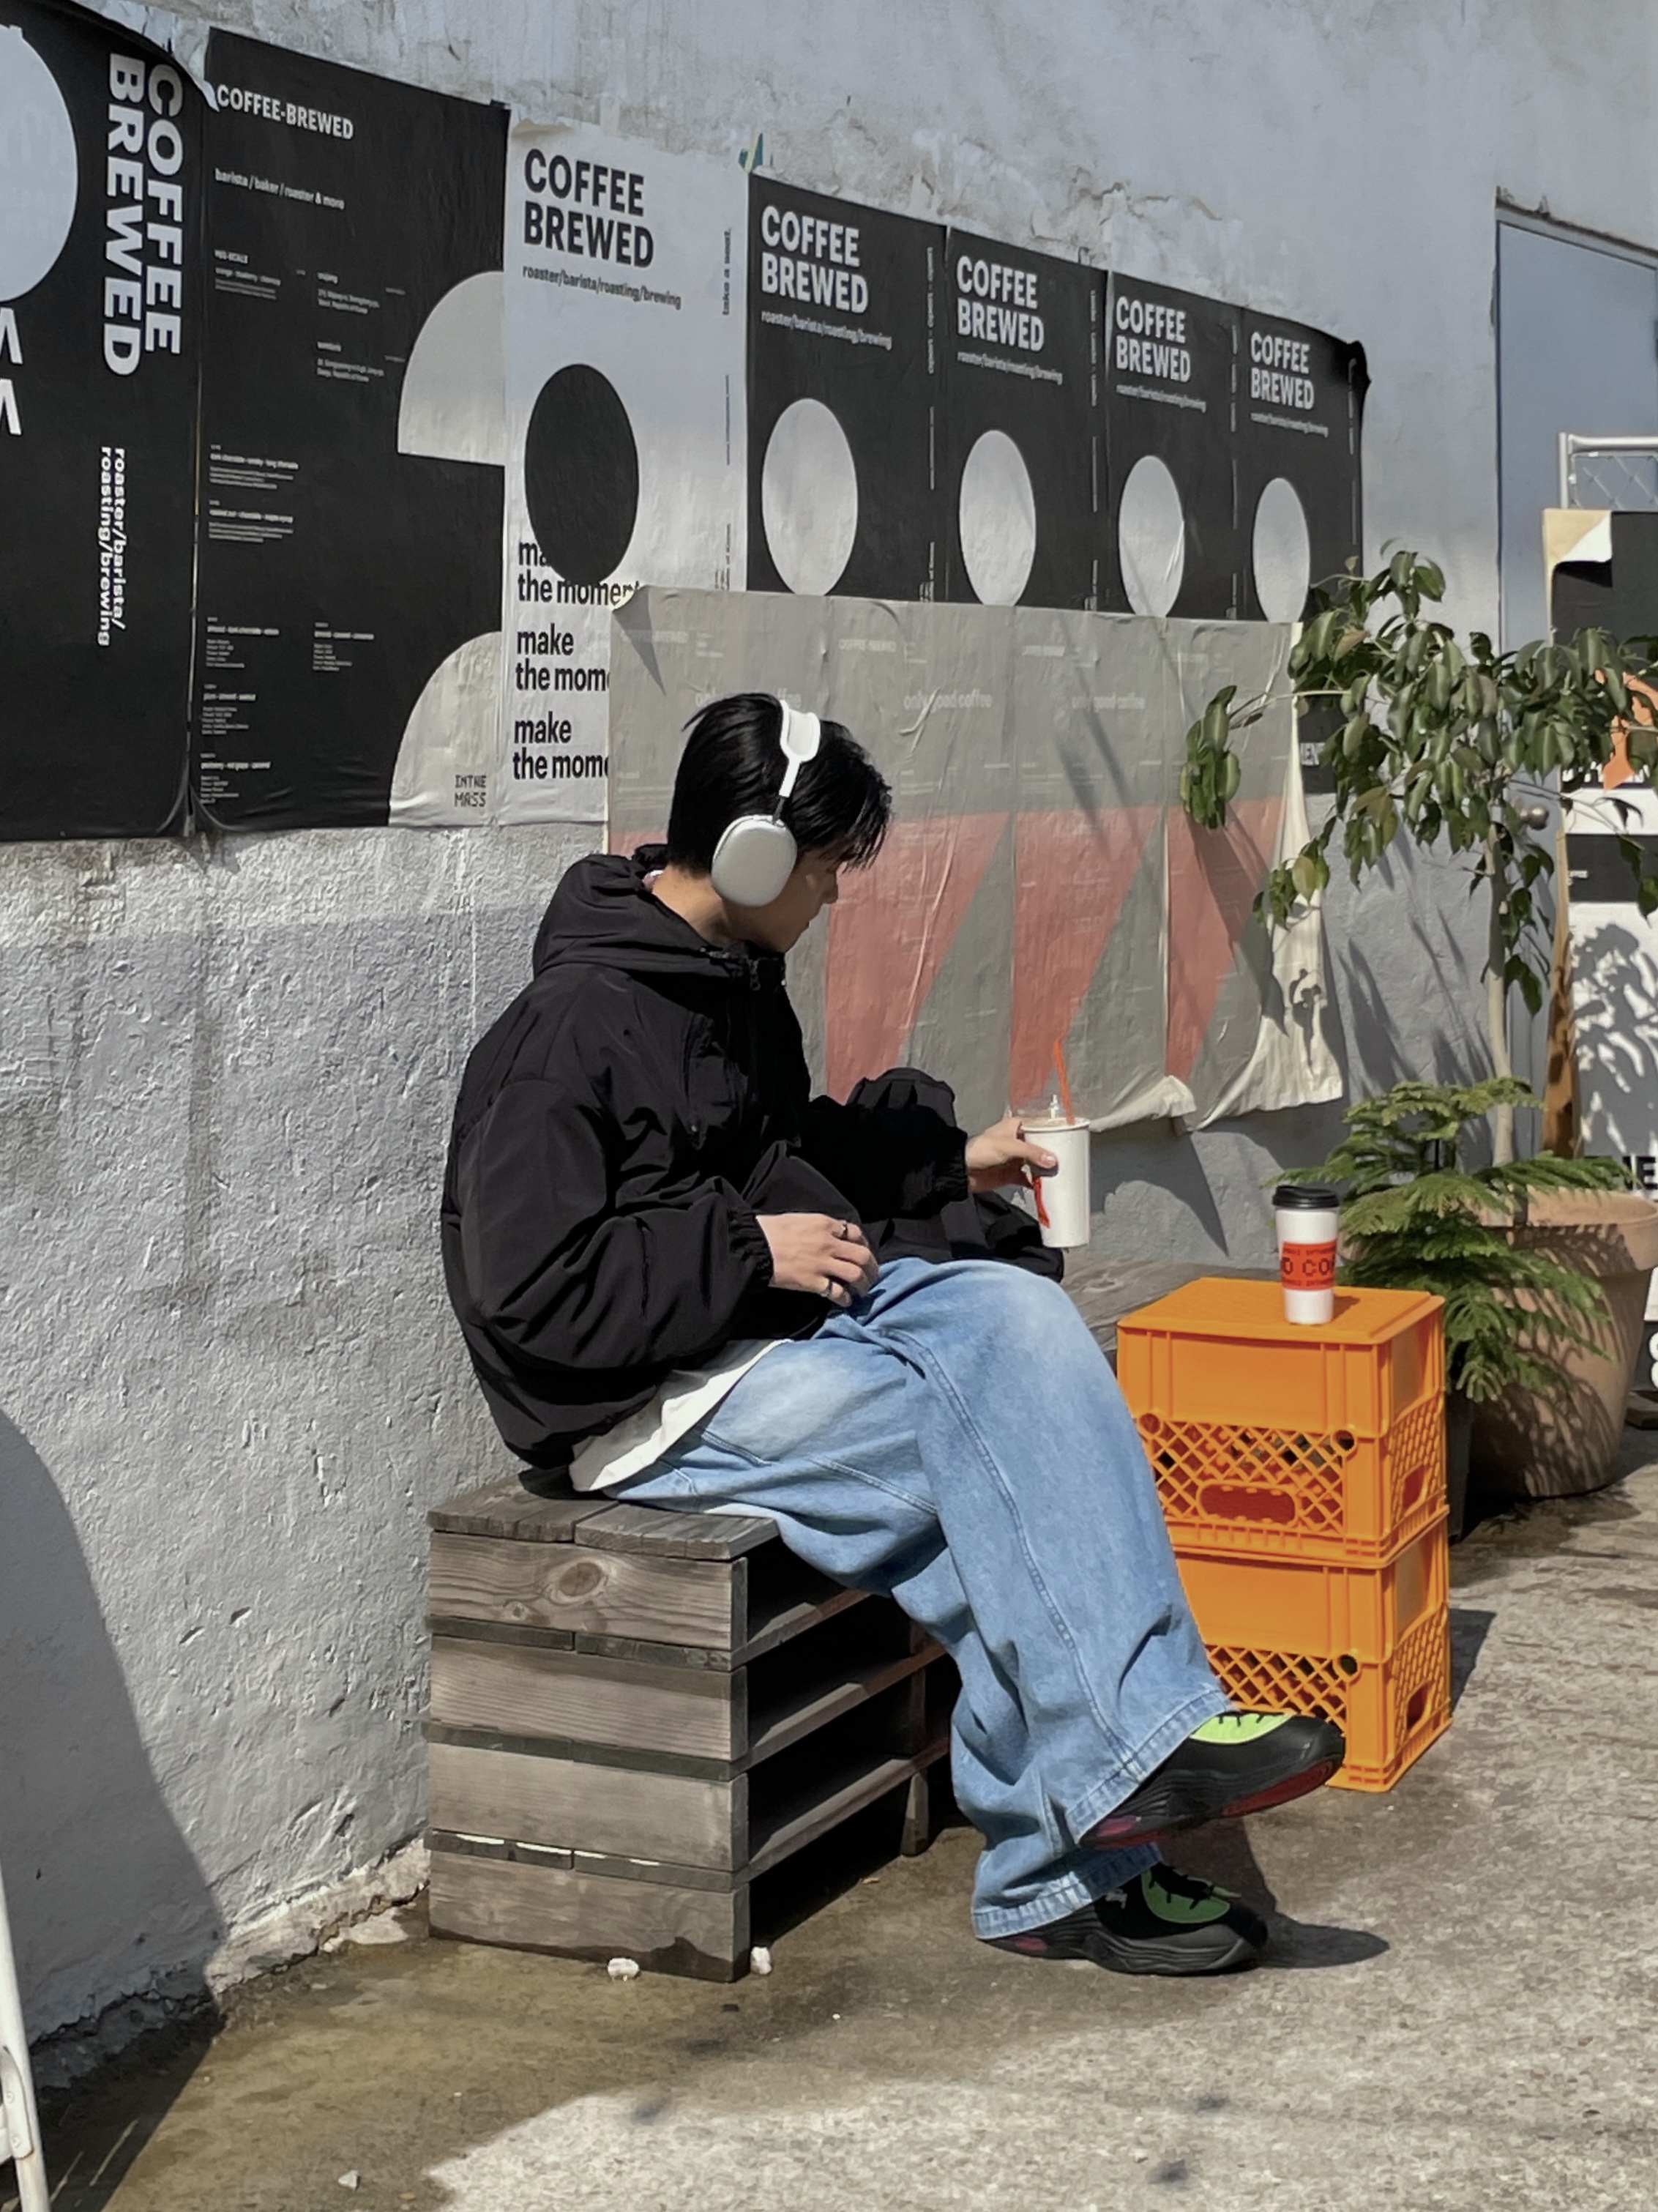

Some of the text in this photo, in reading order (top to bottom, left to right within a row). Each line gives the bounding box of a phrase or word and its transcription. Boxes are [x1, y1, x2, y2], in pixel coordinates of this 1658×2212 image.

[524, 149, 644, 217] COFFEE
[104, 53, 145, 376] BREWED
[145, 64, 183, 354] COFFEE
[524, 200, 654, 268] BREWED
[761, 205, 860, 267] COFFEE
[523, 266, 682, 310] roaster/barista/roasting/brewing
[761, 251, 868, 313] BREWED
[957, 256, 1037, 310] COFFEE
[957, 297, 1044, 351] BREWED
[1116, 296, 1185, 343] COFFEE
[1116, 335, 1190, 382] BREWED
[1250, 332, 1310, 374] COFFEE
[1250, 367, 1315, 410] BREWED
[518, 569, 553, 602] the
[517, 623, 574, 655] make
[515, 658, 610, 691] the mom
[515, 711, 572, 743] make
[512, 747, 548, 779] the
[455, 792, 486, 808] MASS
